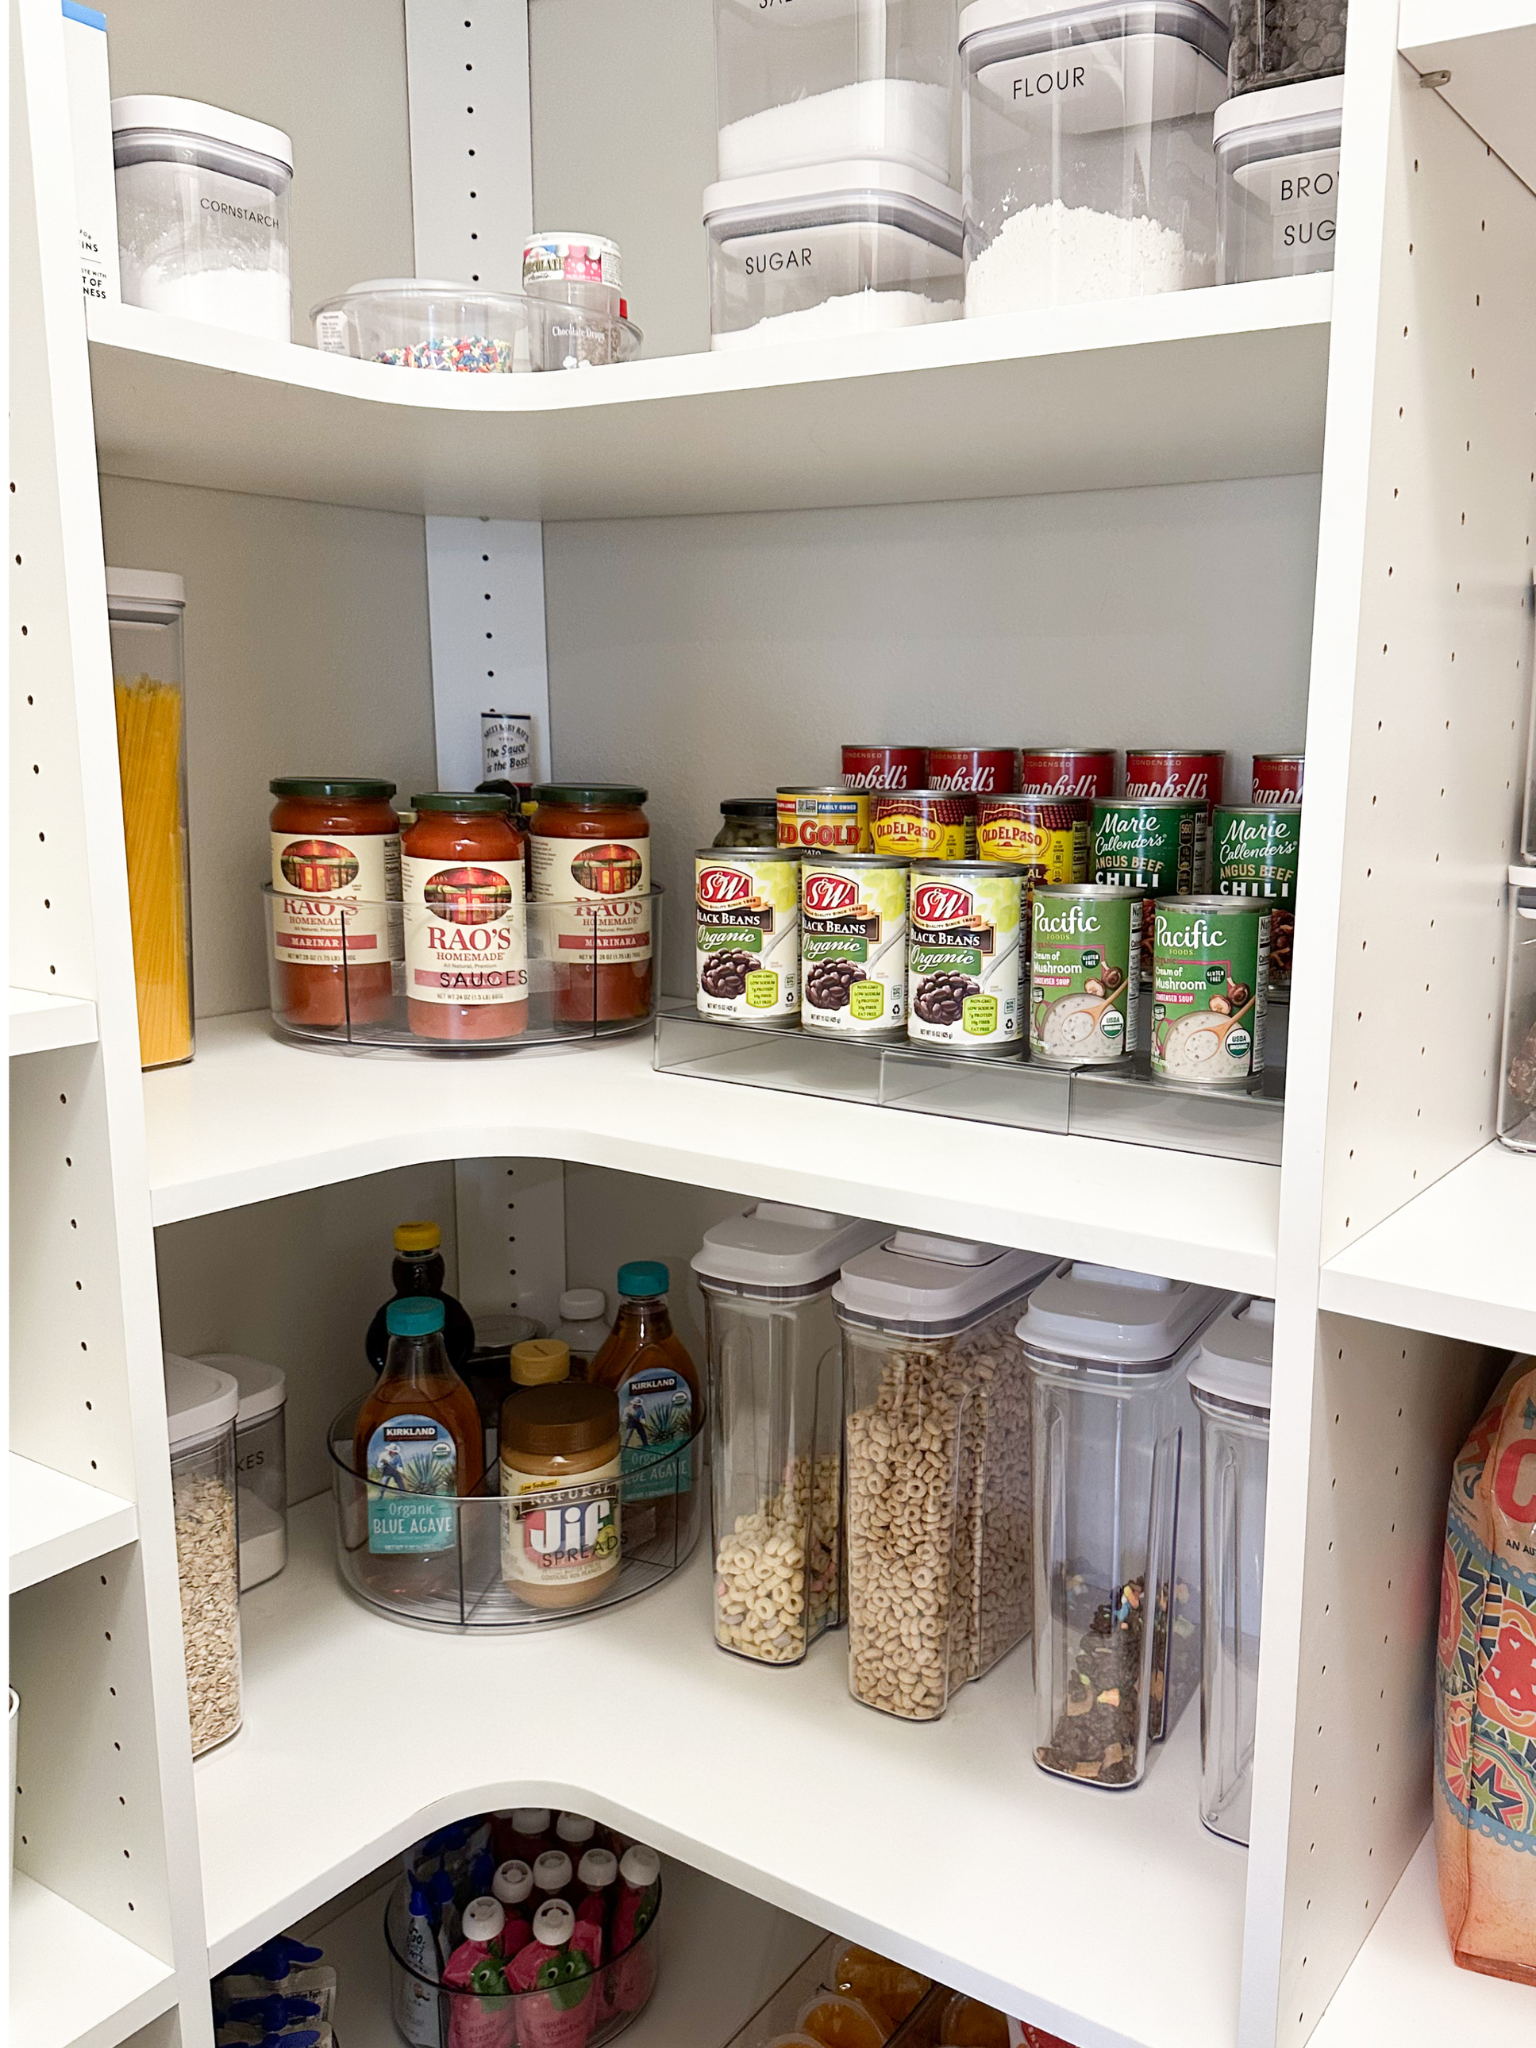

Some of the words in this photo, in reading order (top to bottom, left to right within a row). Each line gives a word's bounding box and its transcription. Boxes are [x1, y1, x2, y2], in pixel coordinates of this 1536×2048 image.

[1013, 66, 1085, 100] FLOUR
[1281, 170, 1339, 200] BRO
[200, 198, 279, 230] CORNSTARCH
[745, 248, 812, 275] SUGAR
[90, 278, 103, 288] OF
[486, 747, 499, 759] The
[501, 743, 526, 756] Sauce
[494, 760, 507, 772] the
[799, 819, 861, 847] GOLD
[876, 824, 893, 839] OLD
[1095, 813, 1161, 837] Marie
[1220, 819, 1291, 845] Marie
[982, 828, 998, 843] OLD
[1095, 833, 1165, 856] Callender's
[1220, 841, 1296, 865] Callender's
[1095, 855, 1128, 870] ANGUS
[1131, 856, 1166, 873] BEEF
[1220, 863, 1256, 880] ANGUS
[1258, 864, 1295, 882] BEEF
[1095, 871, 1159, 888] CHILI
[1220, 880, 1289, 898] CHILI
[283, 895, 359, 917] RAO'S
[573, 896, 643, 917] RAO'S
[721, 912, 761, 925] BEANS
[826, 920, 866, 934] BEANS
[1032, 902, 1101, 935] Pacific
[427, 926, 511, 951] RAO'S
[697, 924, 756, 950] Organic
[938, 932, 980, 946] BEANS
[1154, 915, 1227, 950] Pacific
[803, 932, 861, 960] Organic
[1169, 948, 1194, 956] FOODS
[436, 952, 504, 962] HOMEMADE
[911, 944, 975, 972] Organic
[1051, 950, 1061, 961] of
[1033, 961, 1083, 974] Mushroom
[1155, 966, 1173, 976] Cream
[1173, 966, 1183, 977] of
[440, 969, 528, 988] SAUCES
[1055, 977, 1071, 986] SOUP
[1155, 977, 1207, 991] Mushroom
[1178, 994, 1194, 1003] SOUP
[631, 1378, 676, 1391] KIRKLAND
[386, 1427, 436, 1436] KIRKLAND
[530, 1484, 611, 1506] NATURAL
[389, 1502, 435, 1519] Organic
[373, 1518, 406, 1534] BLUE
[409, 1516, 453, 1533] AGAVE
[529, 1499, 611, 1554] Jif
[542, 1530, 629, 1568] SPREADS
[1506, 1538, 1521, 1551] AN
